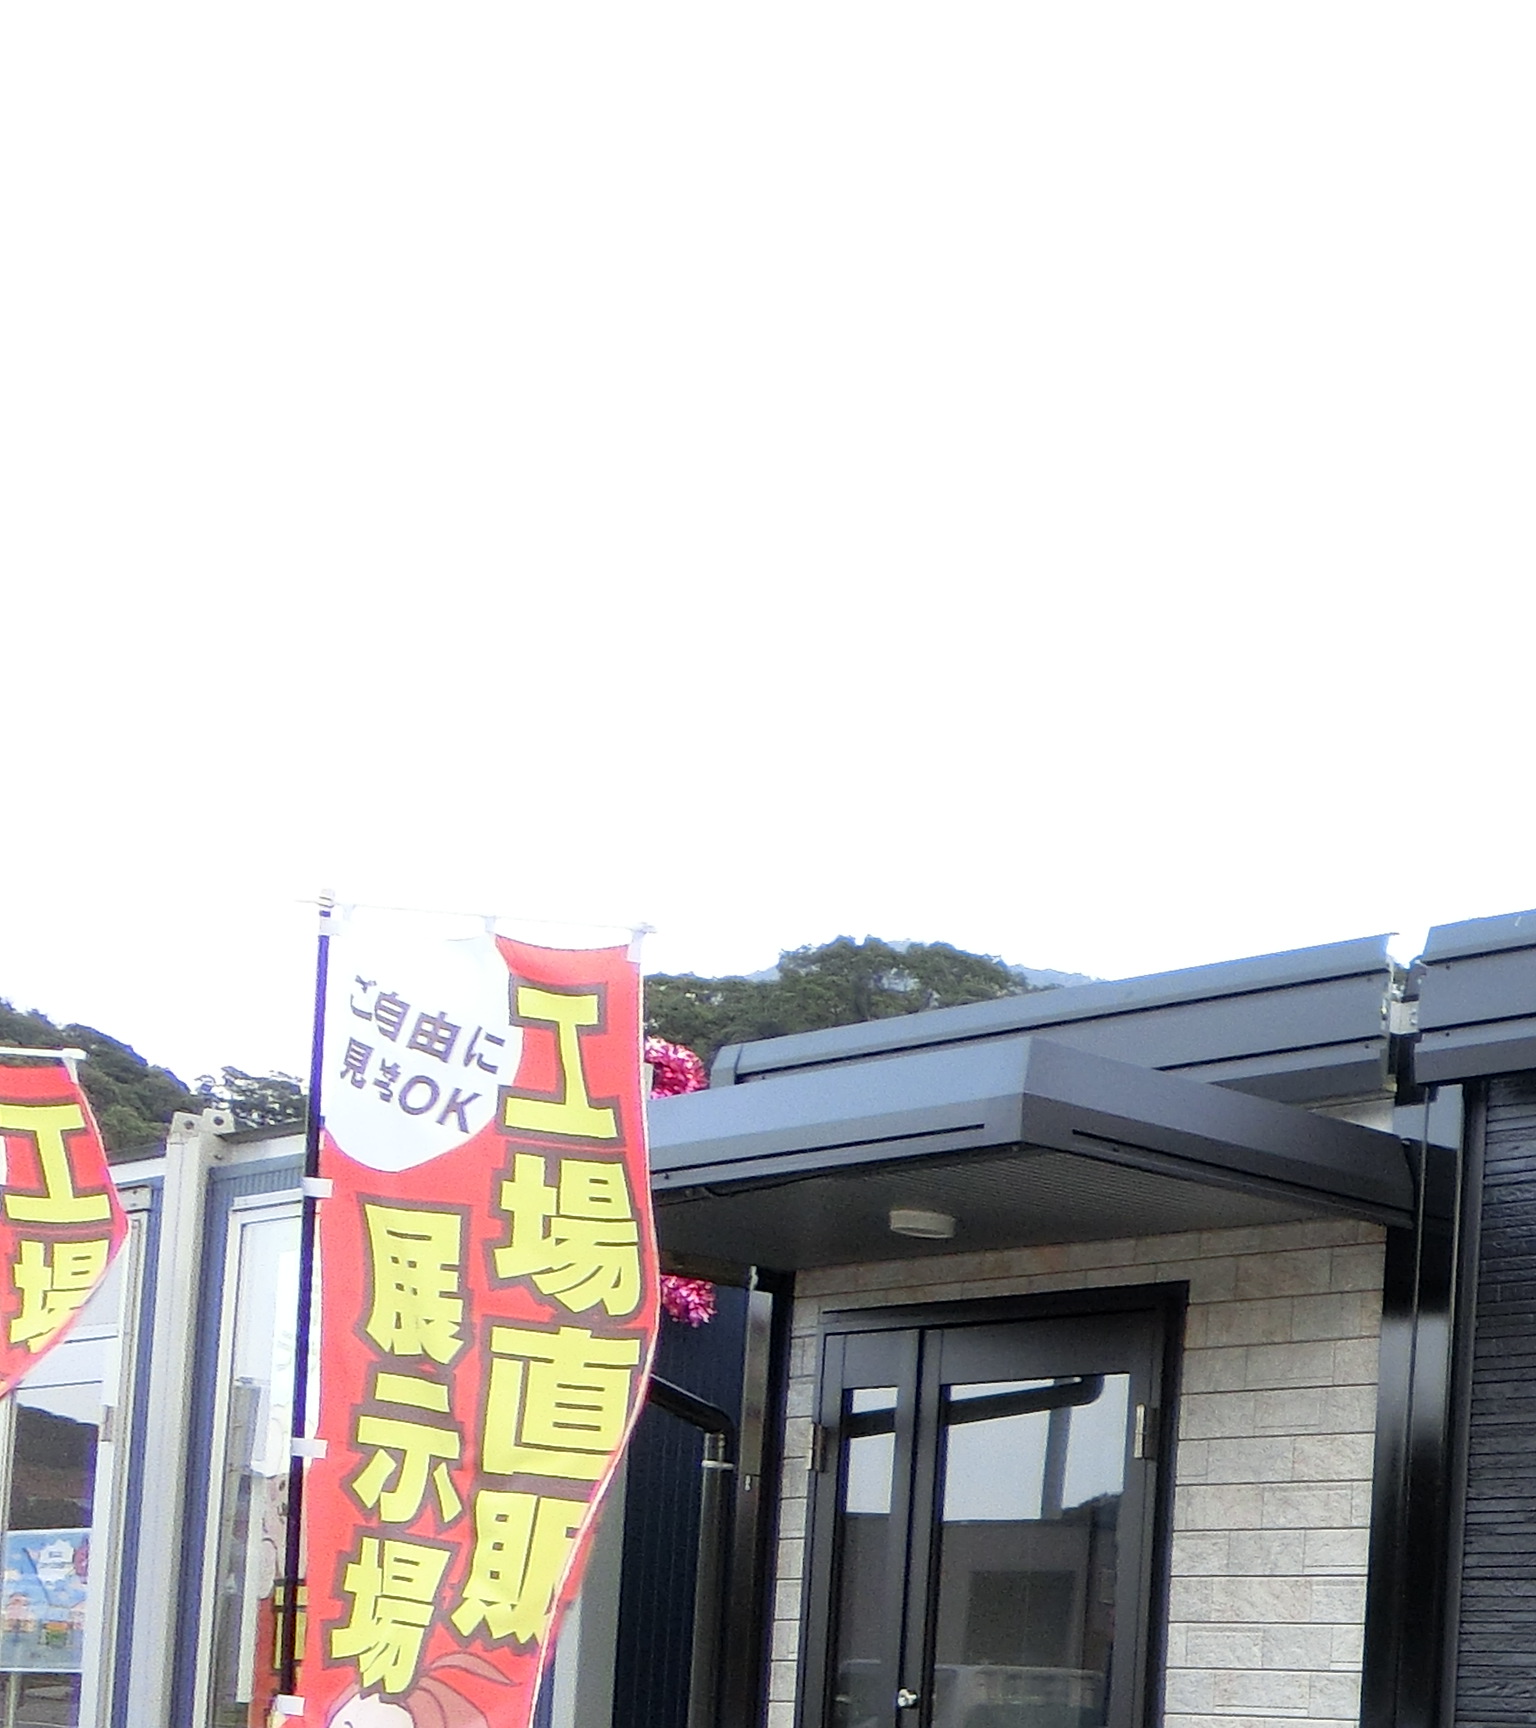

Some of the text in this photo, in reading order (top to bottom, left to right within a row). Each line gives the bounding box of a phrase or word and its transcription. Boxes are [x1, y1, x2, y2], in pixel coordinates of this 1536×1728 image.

[349, 974, 506, 1075] ご自由に
[340, 1036, 482, 1134] 見学OK
[331, 1203, 469, 1696] 展示場
